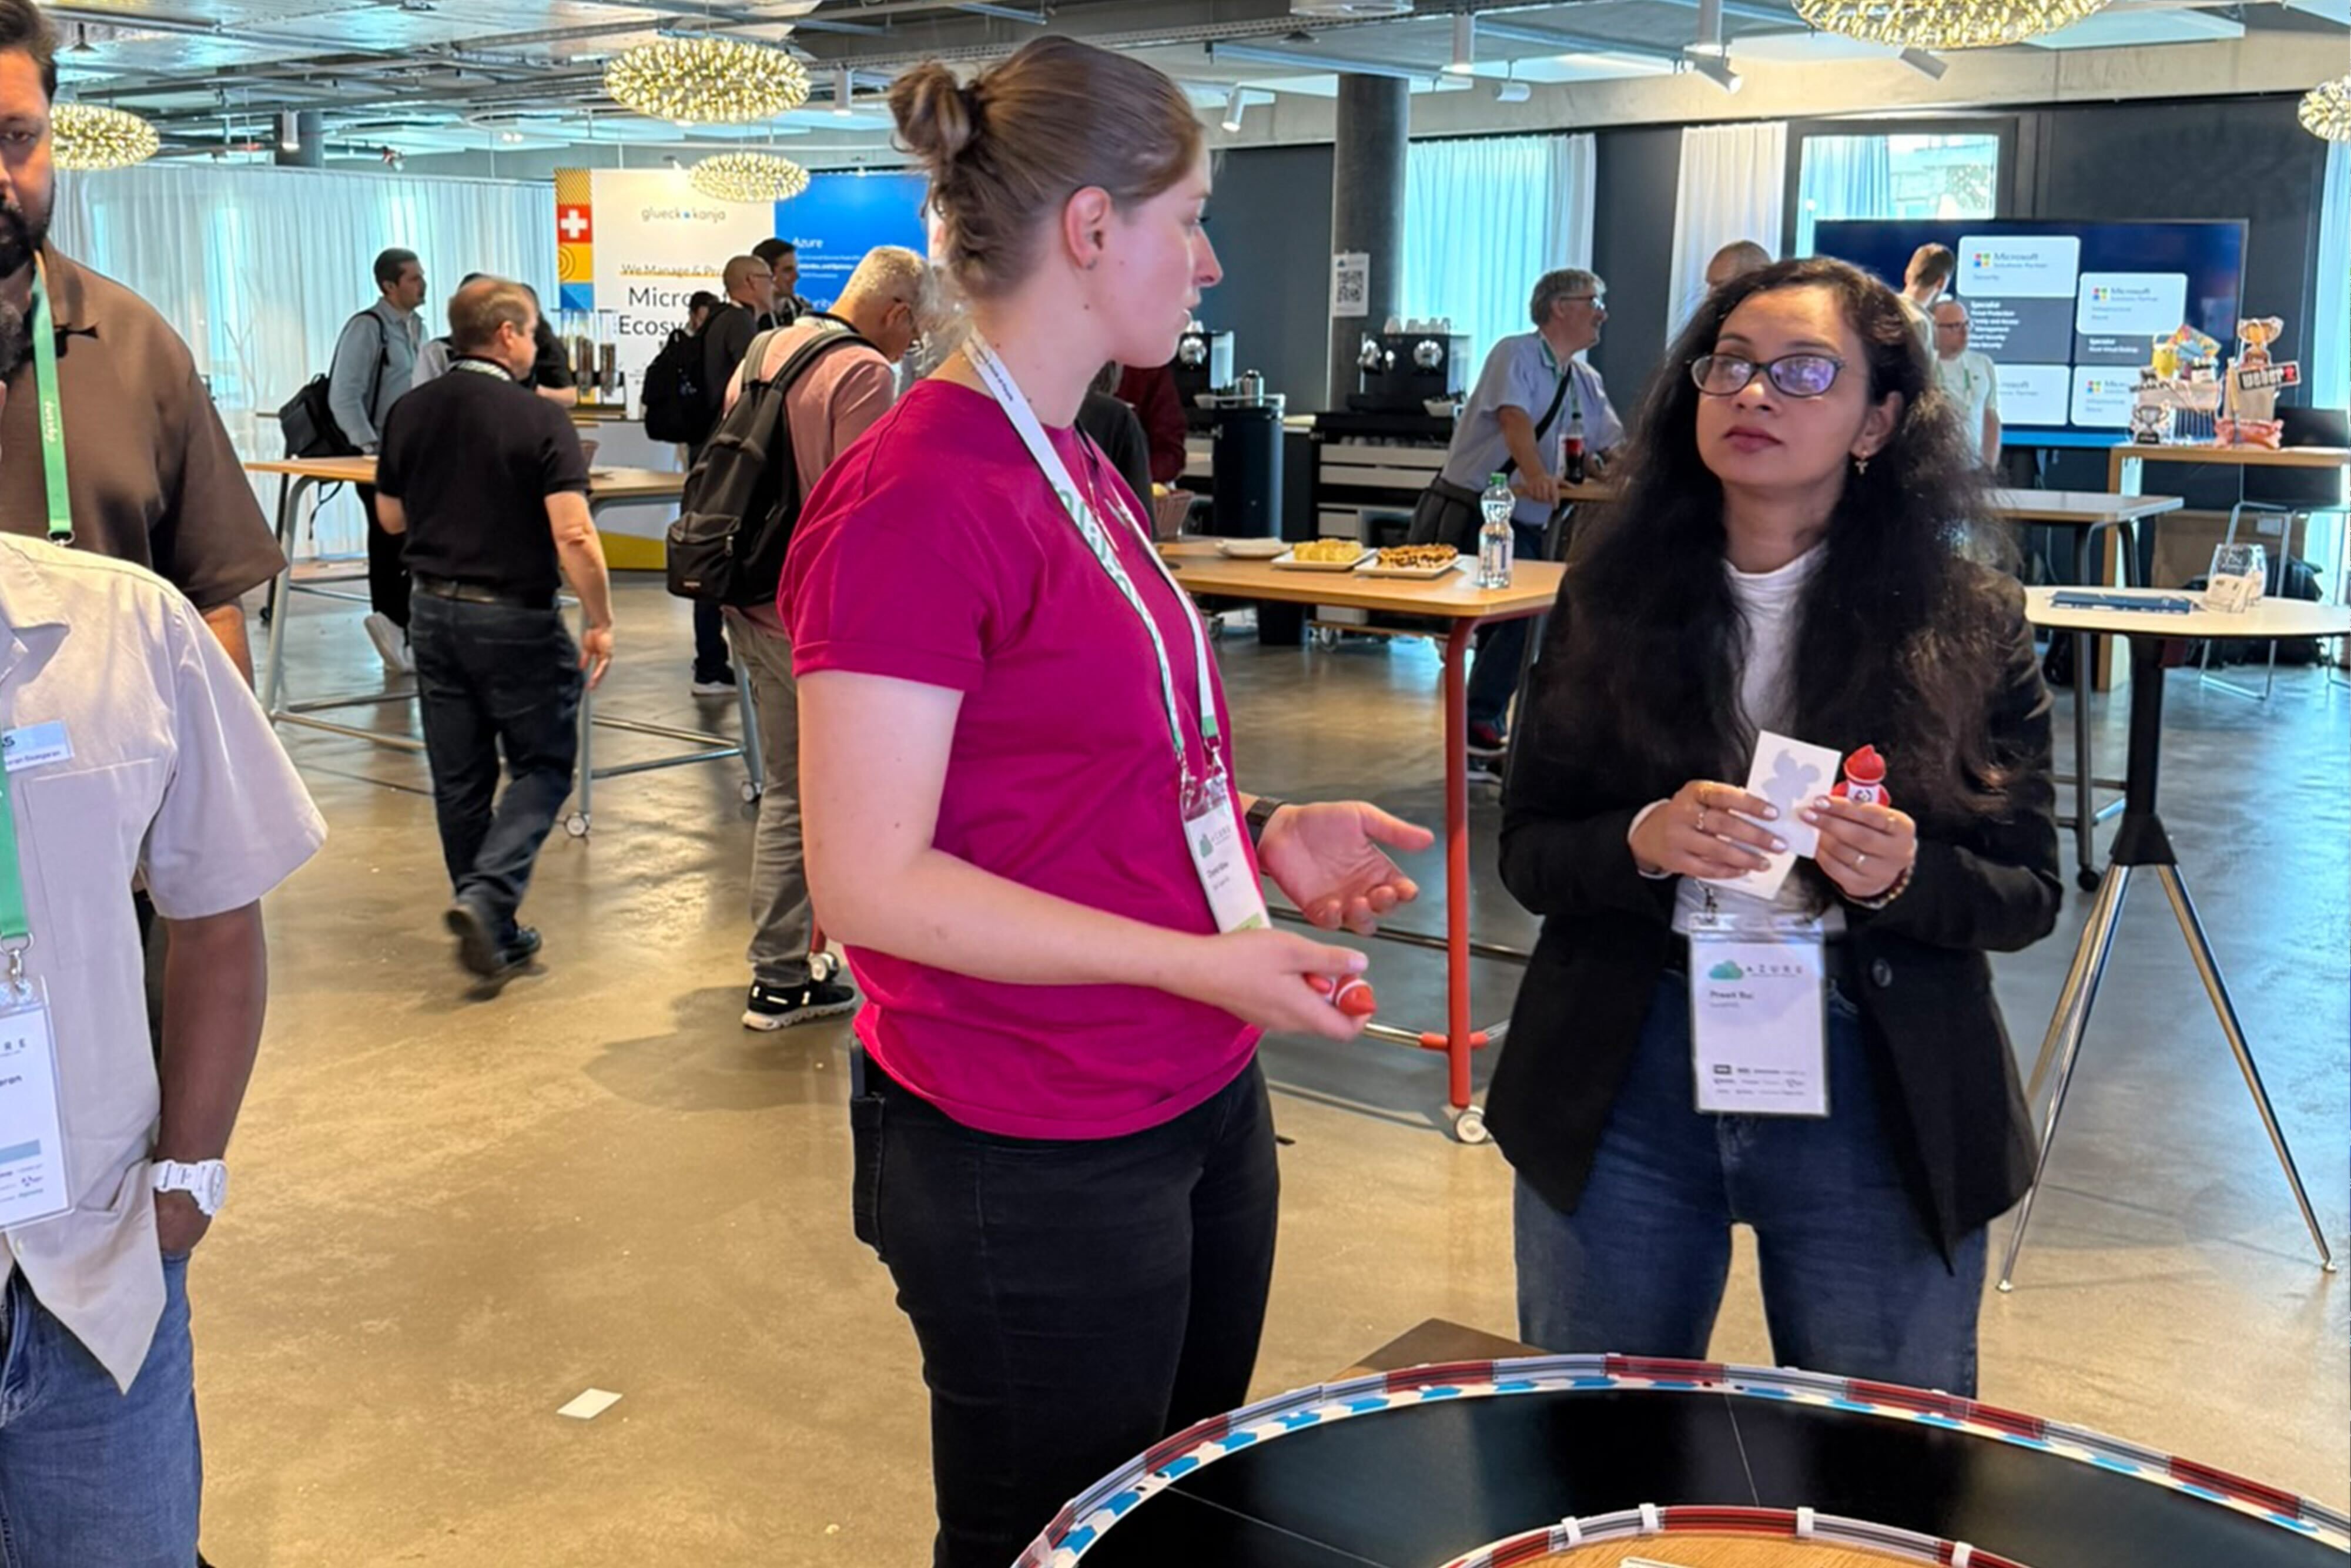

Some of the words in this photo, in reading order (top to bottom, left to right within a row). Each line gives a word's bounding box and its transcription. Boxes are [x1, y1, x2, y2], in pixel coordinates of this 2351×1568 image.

[641, 206, 681, 222] glueck
[692, 206, 726, 224] kanja
[792, 236, 823, 249] Azure
[1994, 252, 2039, 260] Microsoft
